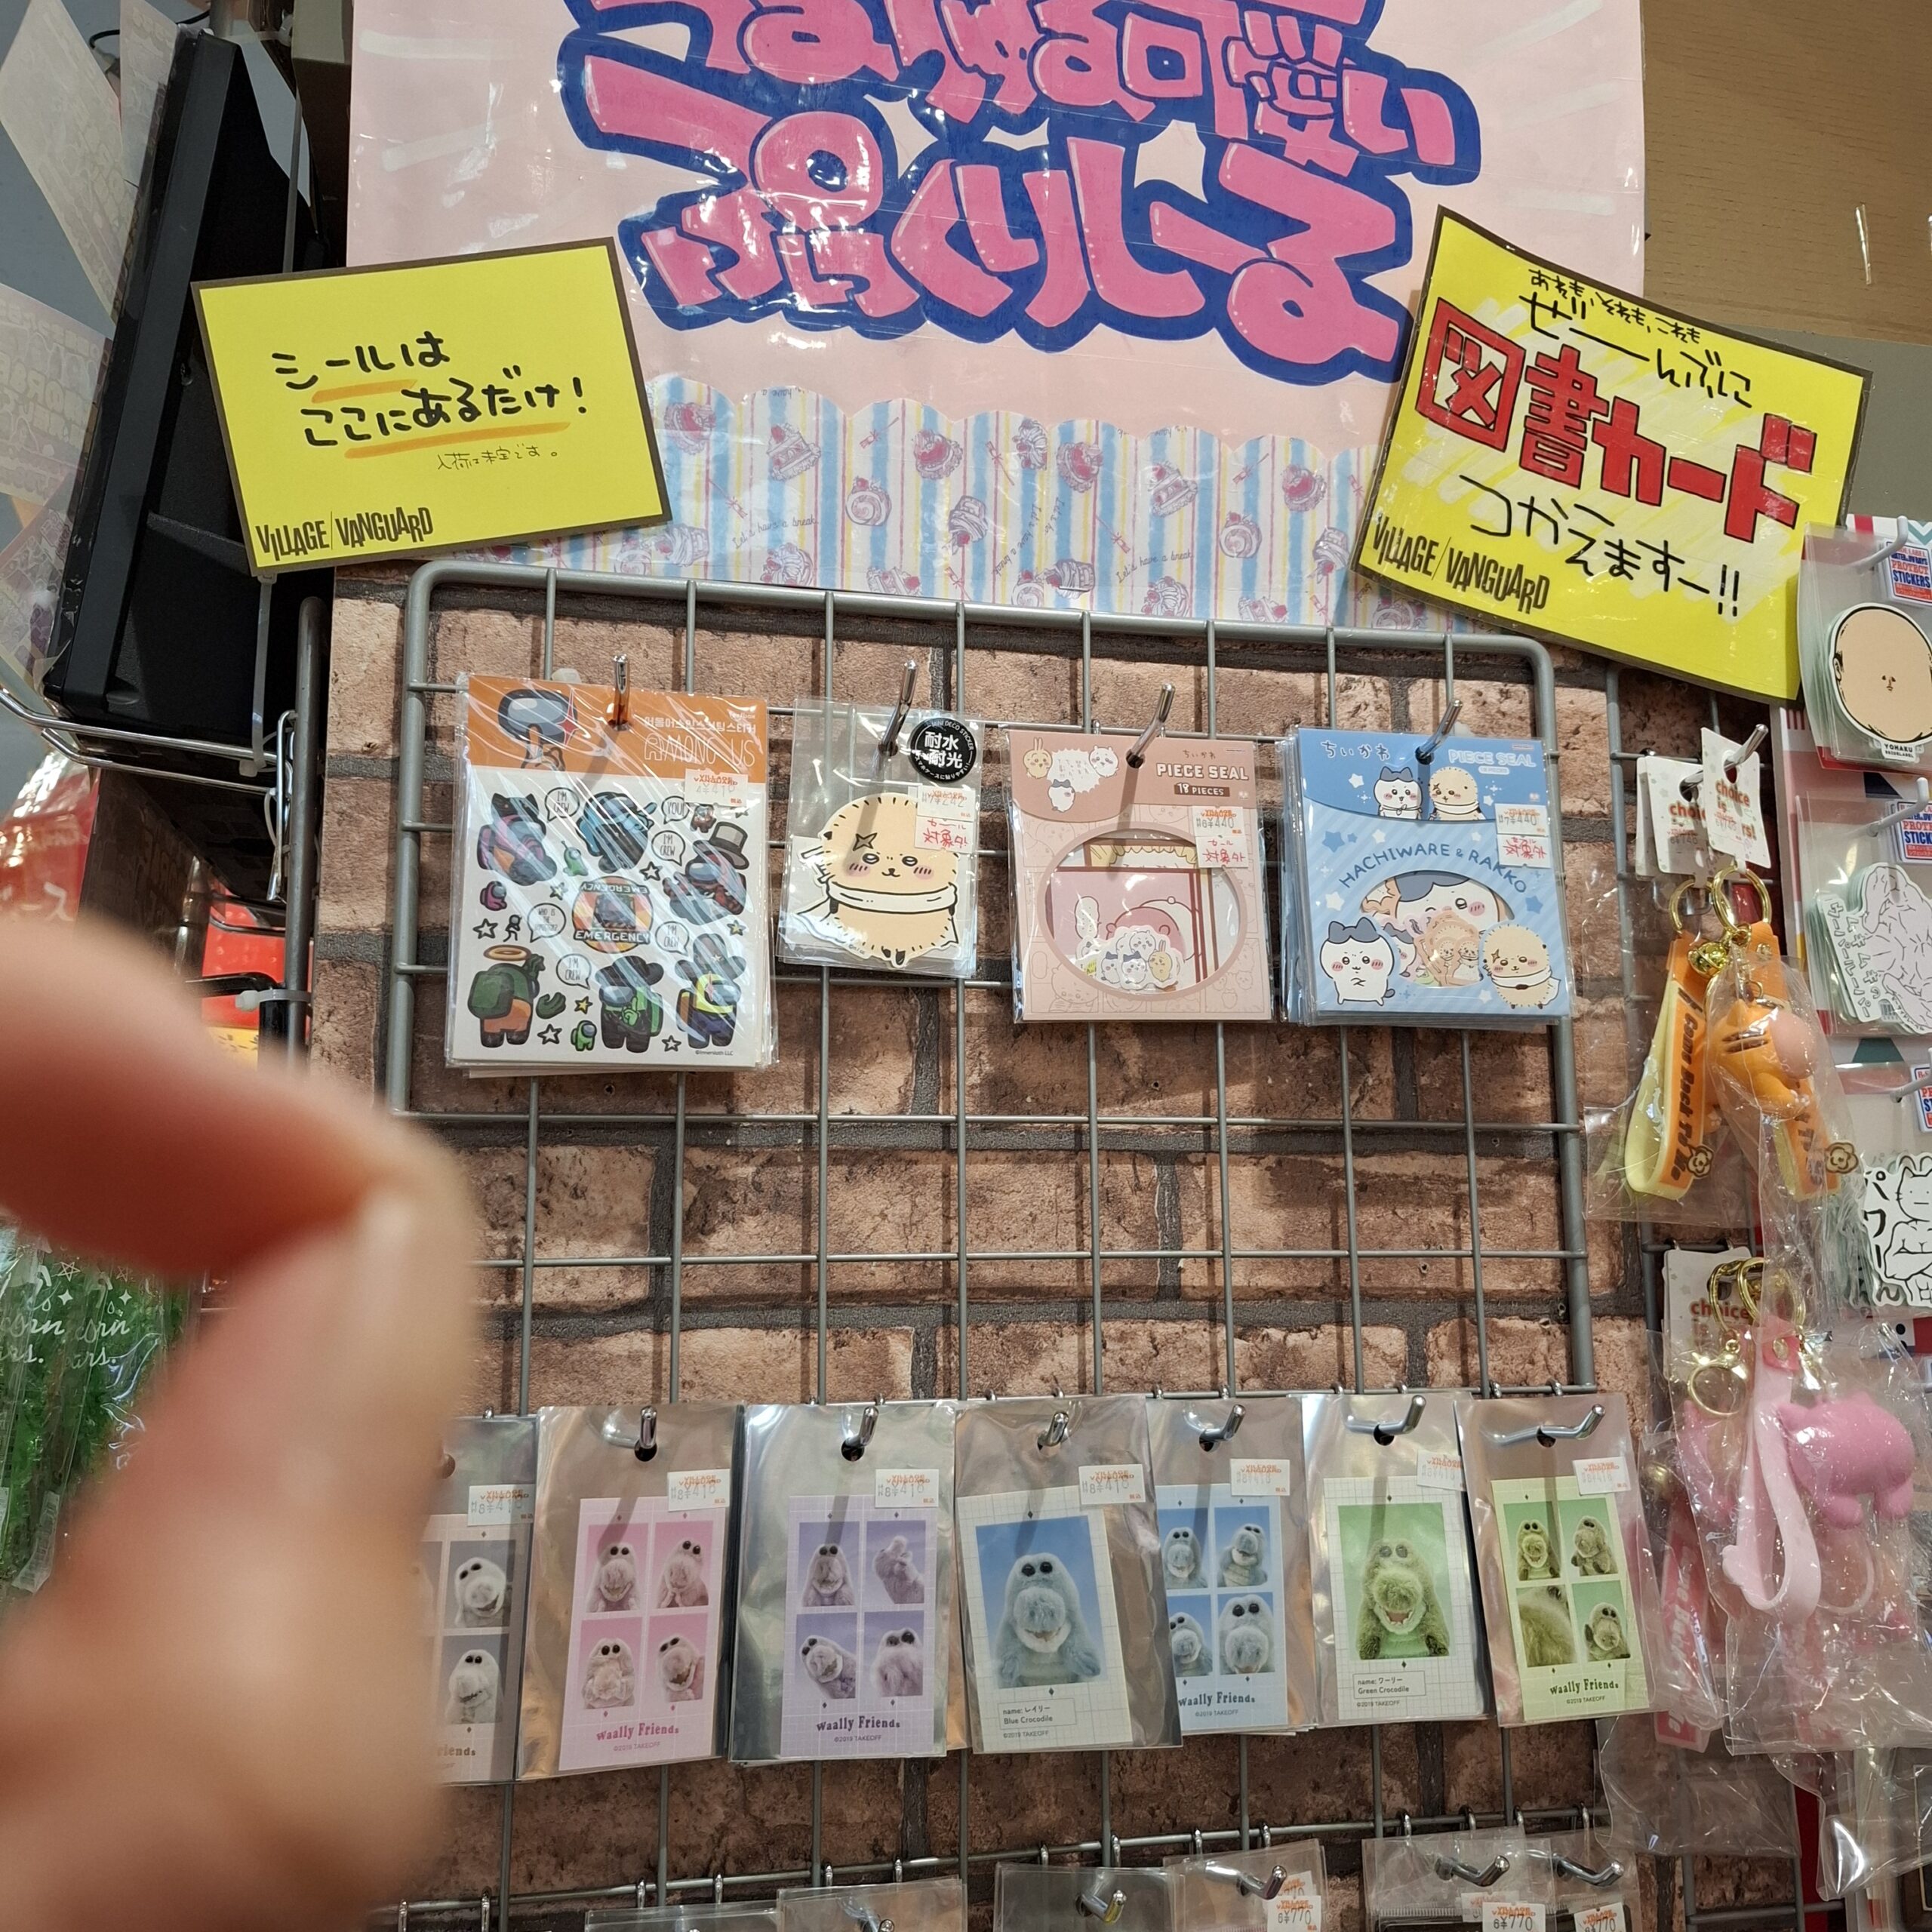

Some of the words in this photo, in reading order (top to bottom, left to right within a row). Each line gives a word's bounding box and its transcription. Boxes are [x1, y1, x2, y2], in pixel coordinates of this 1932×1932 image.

[271, 330, 451, 391] シールは
[1414, 297, 1817, 543] 図書カード
[1891, 559, 1930, 575] PROTECT
[1893, 570, 1931, 589] STICKERS
[924, 731, 960, 751] 耐水
[944, 720, 961, 731] DECO
[959, 728, 975, 751] STICKER
[644, 732, 717, 765] AMONG
[731, 737, 755, 768] US
[1183, 749, 1217, 759] ちいかわ
[1320, 740, 1391, 761] ちいかわ
[1884, 743, 1913, 753] YOHAKU
[928, 748, 964, 769] 耐光
[1447, 749, 1494, 765] PIECE
[1495, 752, 1537, 768] SEAL
[1156, 763, 1204, 779] PIECE
[1208, 764, 1250, 781] SEAL
[1177, 782, 1190, 794] 18
[1192, 787, 1225, 795] PIECES
[1715, 778, 1751, 808] choice
[662, 833, 673, 845] I'M
[659, 844, 675, 857] CREW
[1338, 843, 1451, 889] HACHIWARE
[1455, 848, 1465, 858] &
[1467, 849, 1527, 894] RAKKO
[574, 930, 651, 945] EMERGENCY
[565, 968, 582, 981] CREW
[1680, 1012, 1699, 1065] Come
[1678, 1064, 1695, 1117] Back
[1670, 1148, 1689, 1182] Me
[1216, 1690, 1256, 1704] Friends
[1379, 1685, 1410, 1694] Crocodile
[638, 1722, 679, 1736] Friends
[857, 1715, 900, 1728] Friends
[1004, 1717, 1019, 1725] Blue
[1020, 1715, 1054, 1724] Crocodile
[633, 1741, 661, 1750] TAKEOFF
[1277, 1907, 1312, 1925] 6¥770
[1493, 1913, 1534, 1931] 6¥770
